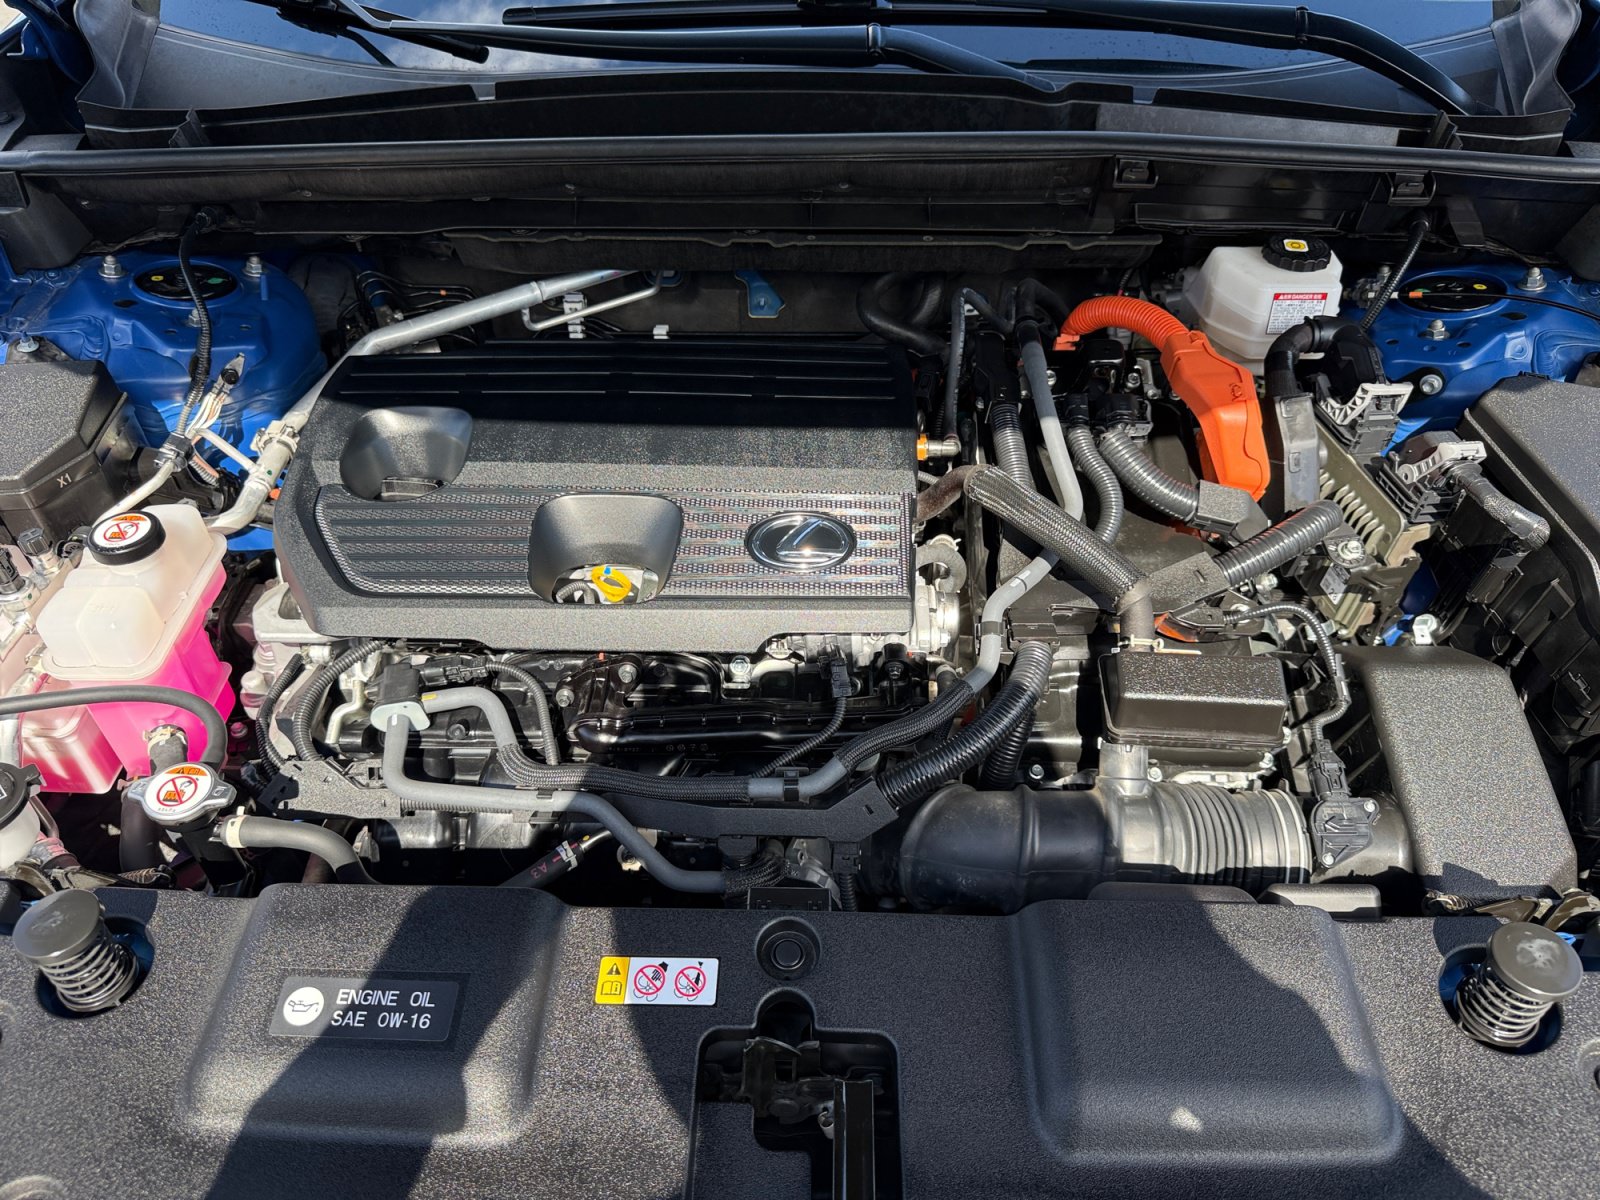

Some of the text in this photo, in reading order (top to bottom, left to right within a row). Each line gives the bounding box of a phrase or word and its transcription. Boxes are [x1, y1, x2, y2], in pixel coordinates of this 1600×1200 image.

[56, 472, 72, 488] X1
[530, 861, 548, 879] A3
[336, 988, 436, 1007] ENGINE OIL
[331, 1010, 431, 1029] SAE 0W-16
